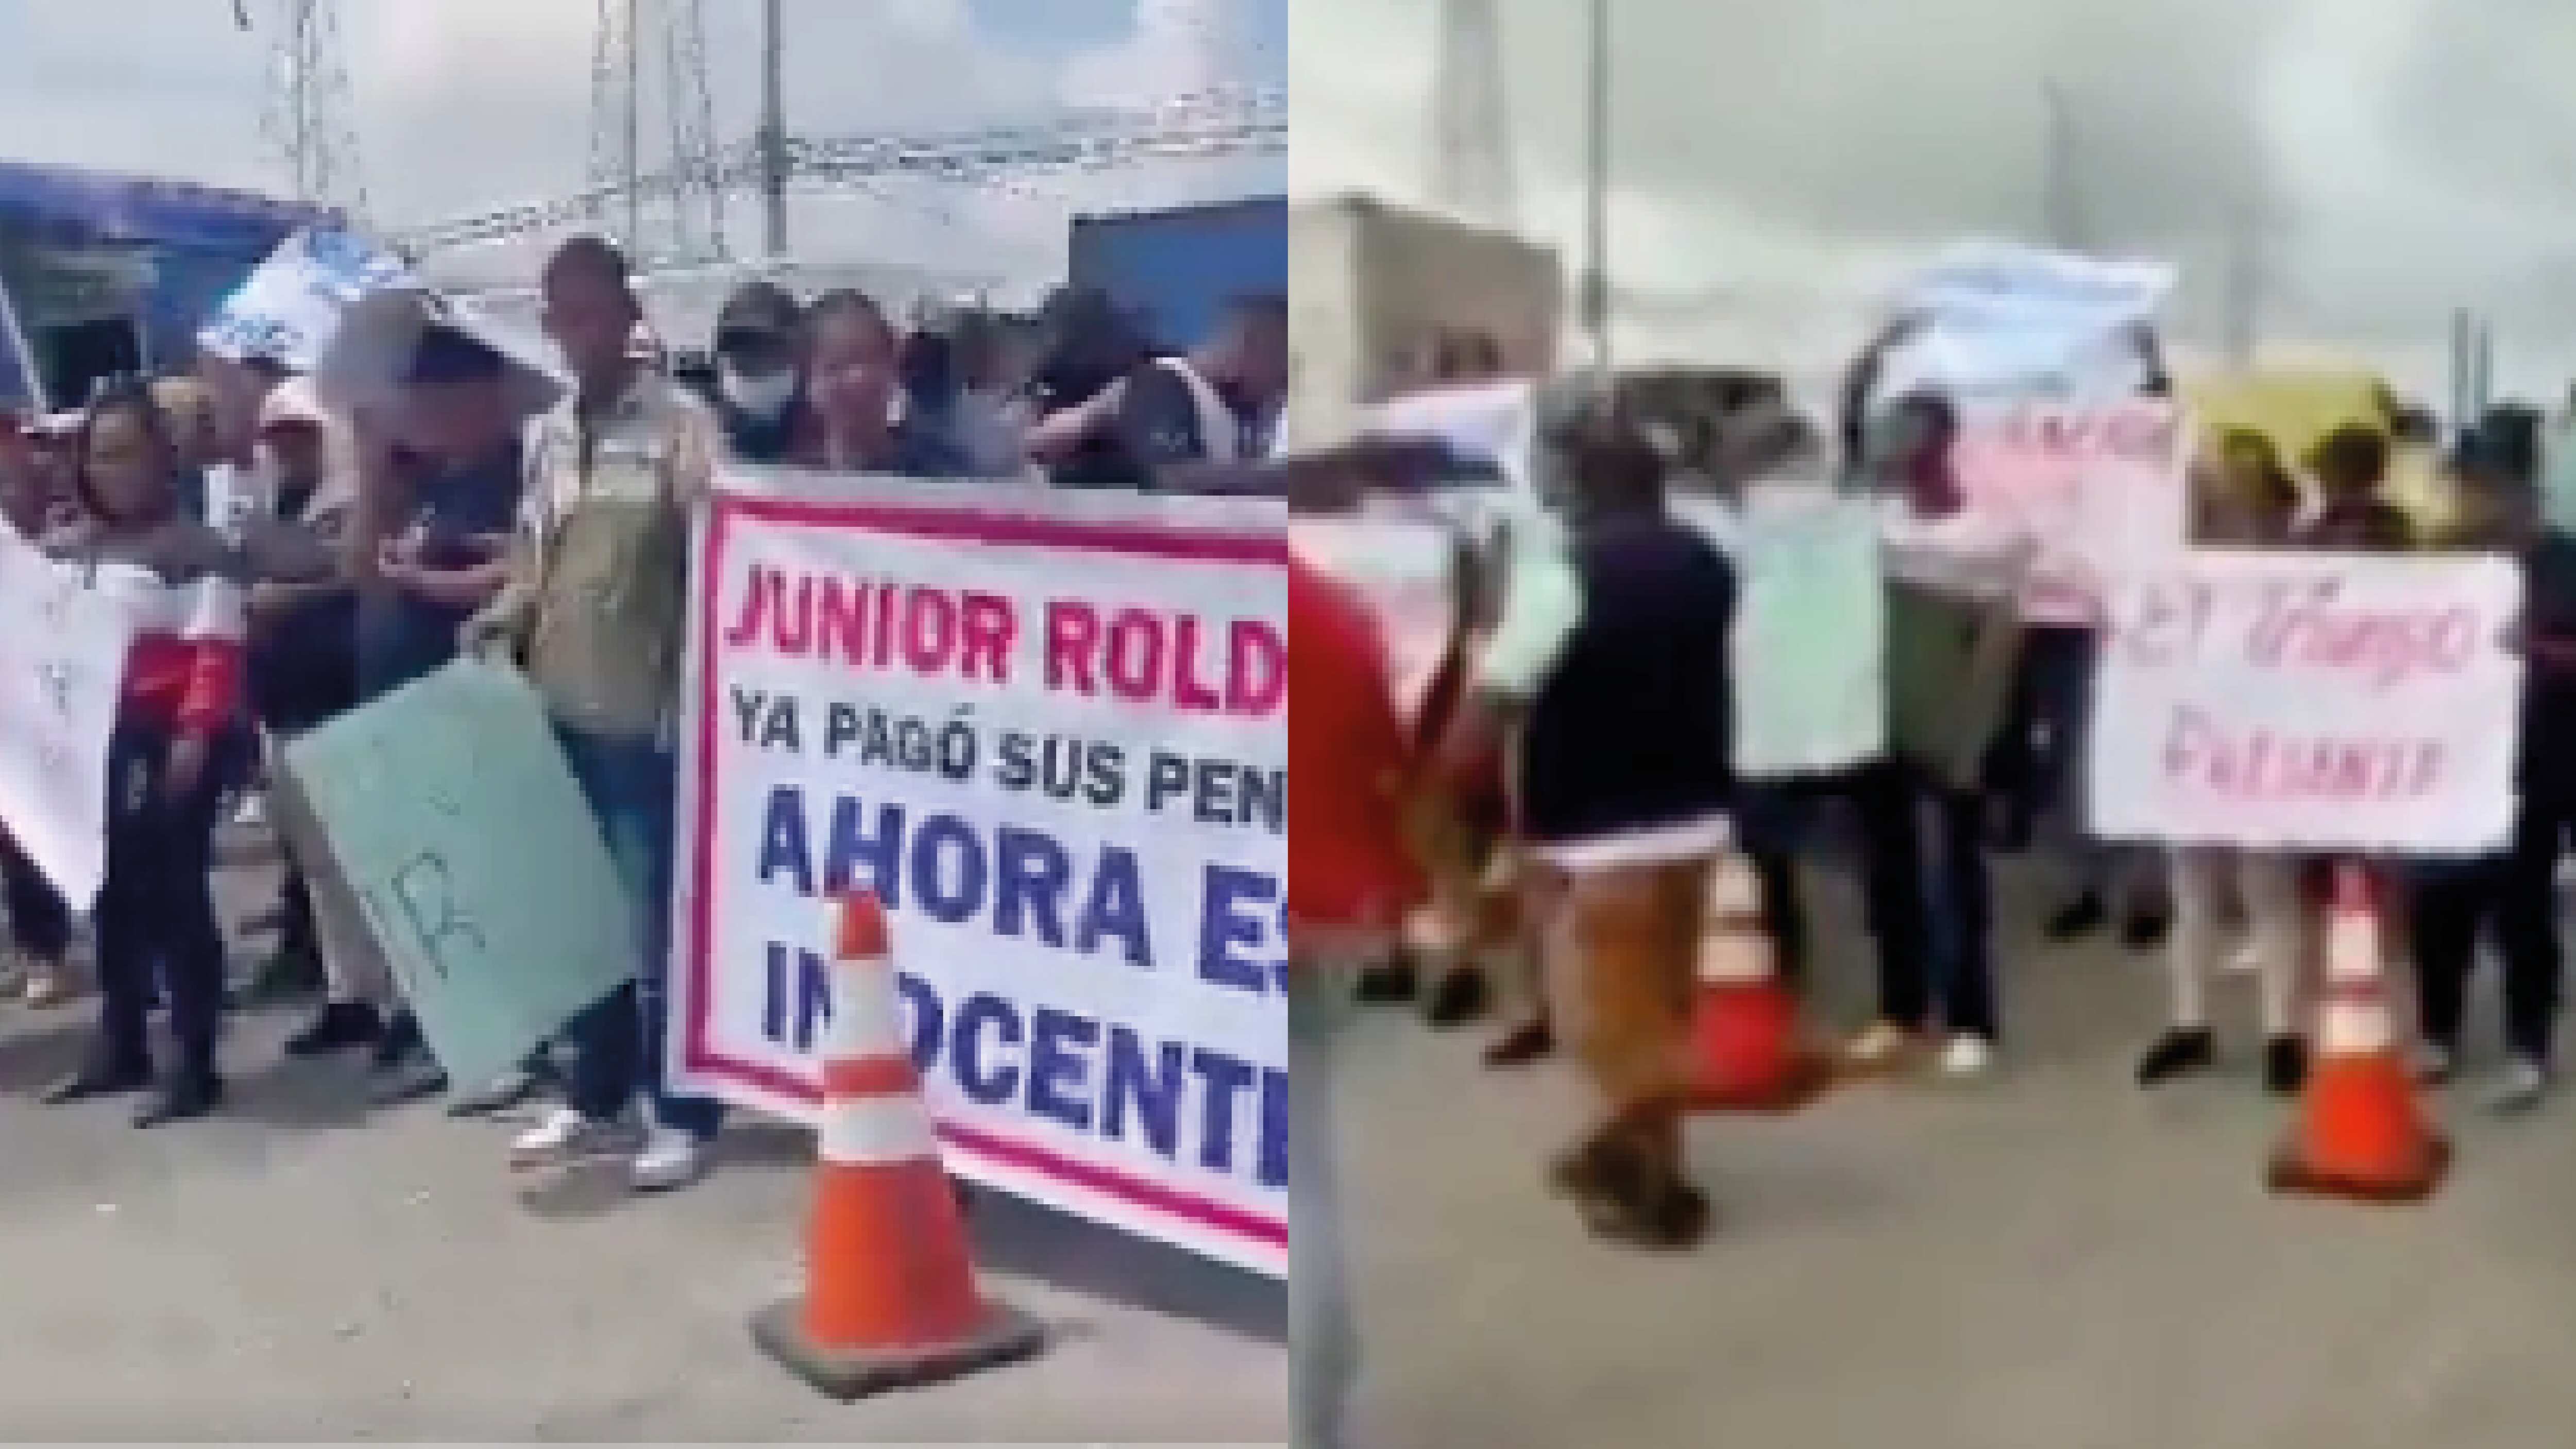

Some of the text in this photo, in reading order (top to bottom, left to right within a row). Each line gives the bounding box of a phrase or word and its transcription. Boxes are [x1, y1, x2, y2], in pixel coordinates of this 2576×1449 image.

[725, 564, 1287, 715] JUNIOR ROLD
[730, 684, 1287, 832] YA PAGÓ SUS PEN
[759, 785, 1287, 997] AHORA E
